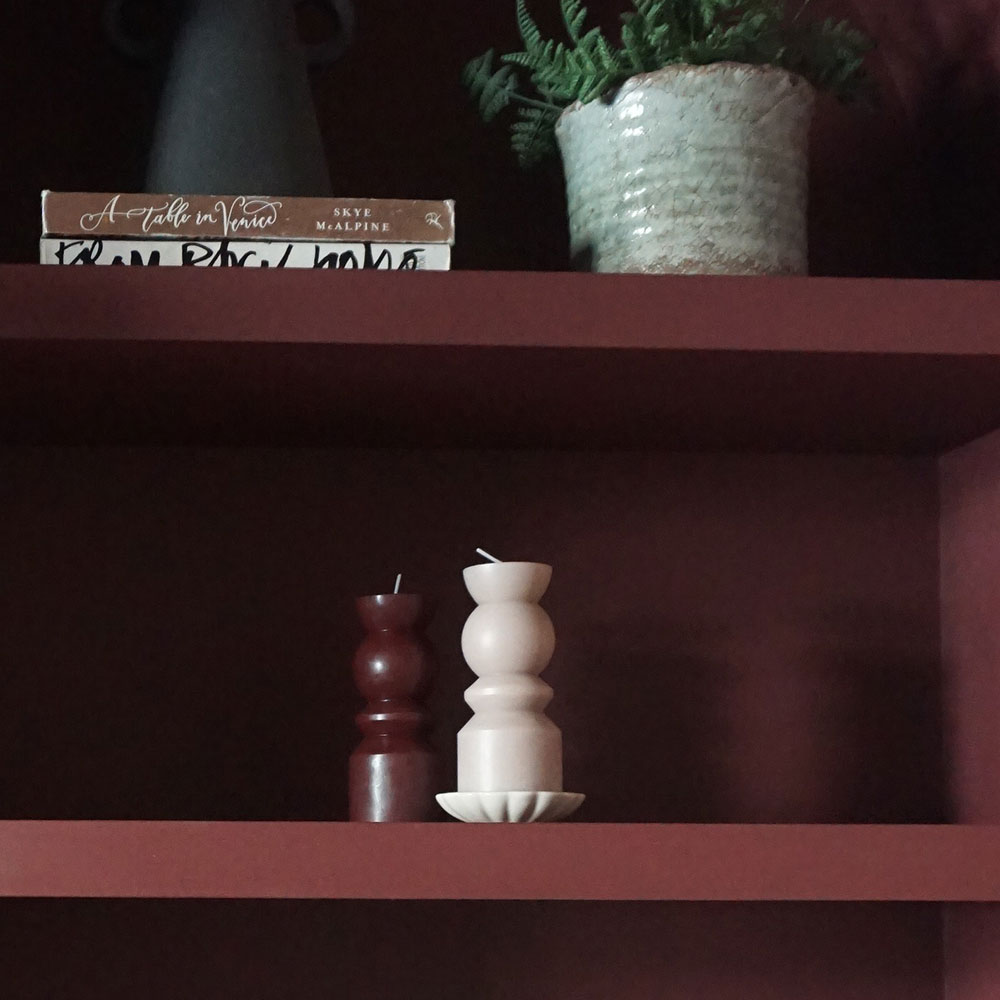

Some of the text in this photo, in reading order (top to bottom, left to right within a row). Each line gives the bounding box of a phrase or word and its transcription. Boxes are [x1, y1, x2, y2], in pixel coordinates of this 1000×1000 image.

[80, 194, 282, 236] A Table in Venice
[333, 207, 372, 217] SKYE
[316, 221, 391, 232] McALPINE
